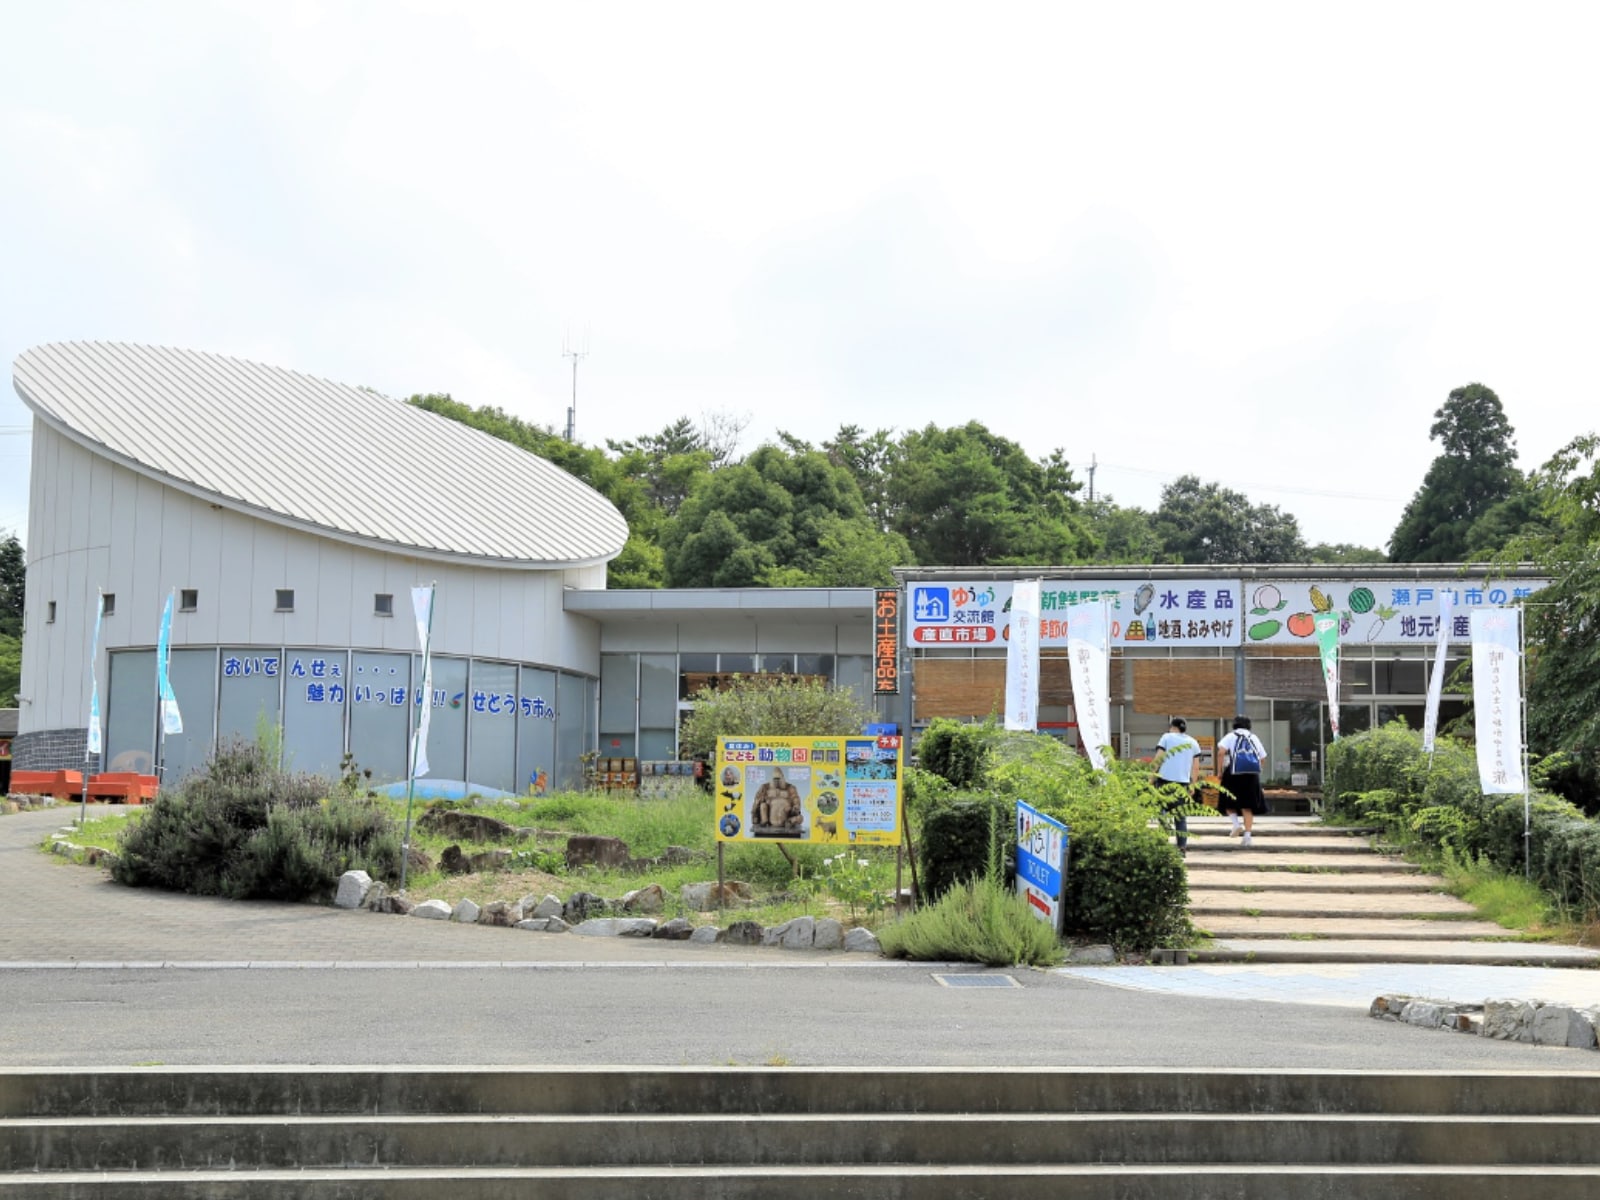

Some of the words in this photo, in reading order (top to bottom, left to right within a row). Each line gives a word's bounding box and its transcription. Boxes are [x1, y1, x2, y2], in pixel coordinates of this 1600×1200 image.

[952, 586, 996, 607] ゆうゆう
[1159, 590, 1234, 610] 水産品
[953, 610, 995, 624] 交流館
[921, 627, 988, 641] 産直市場
[1158, 619, 1234, 639] 地酒、おみやげ
